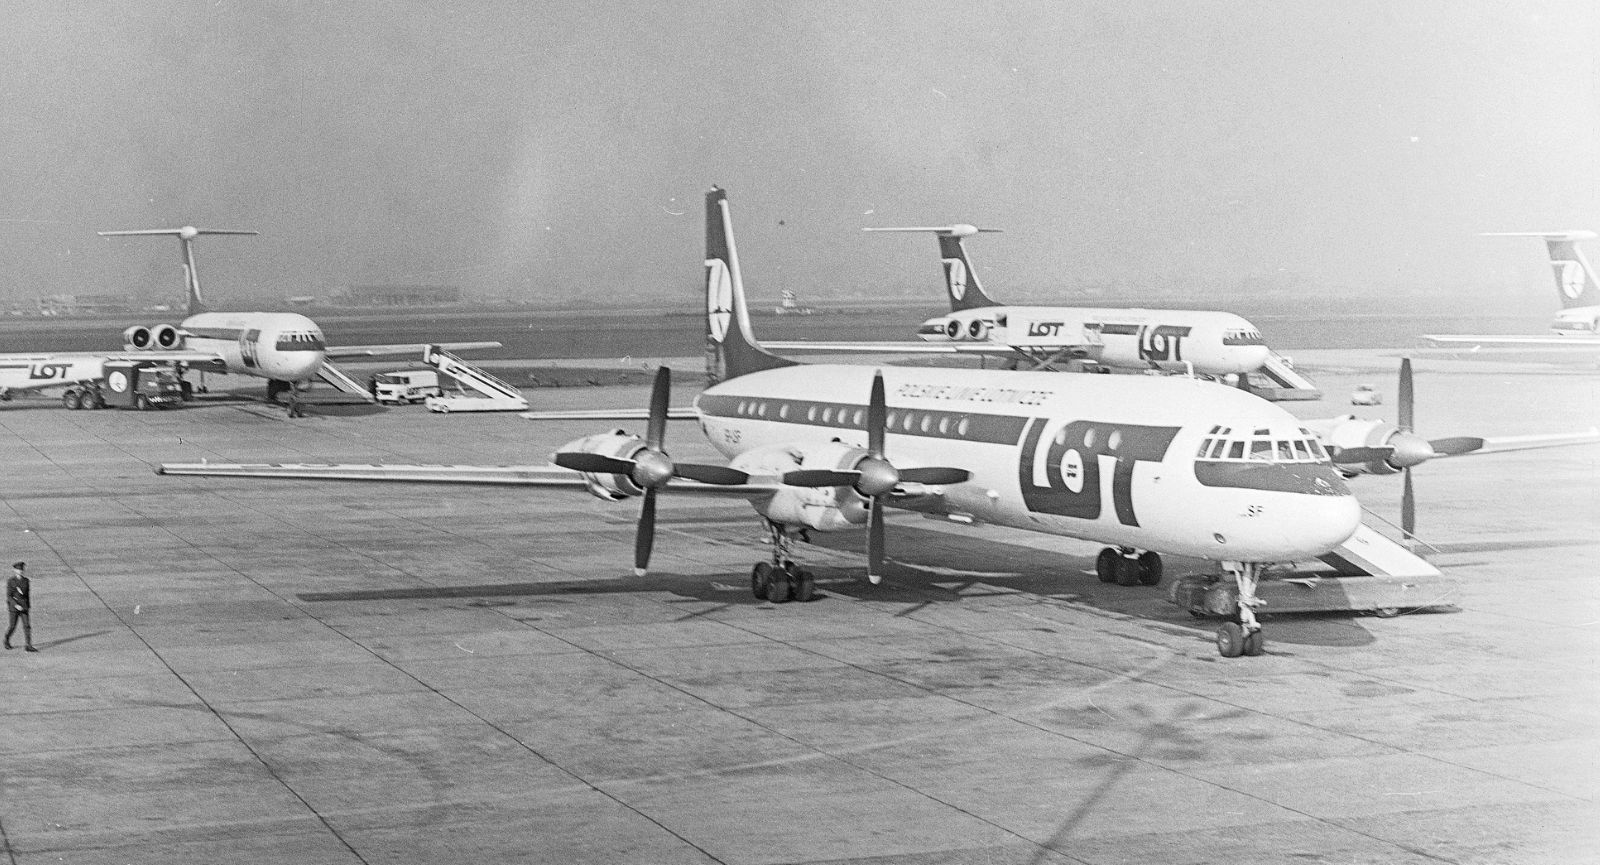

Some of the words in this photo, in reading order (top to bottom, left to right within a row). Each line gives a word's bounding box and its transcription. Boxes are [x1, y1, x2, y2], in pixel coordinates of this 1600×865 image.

[1027, 322, 1065, 337] LOT
[1139, 325, 1193, 361] LOT
[29, 363, 73, 380] LOT
[1019, 418, 1183, 528] LOT
